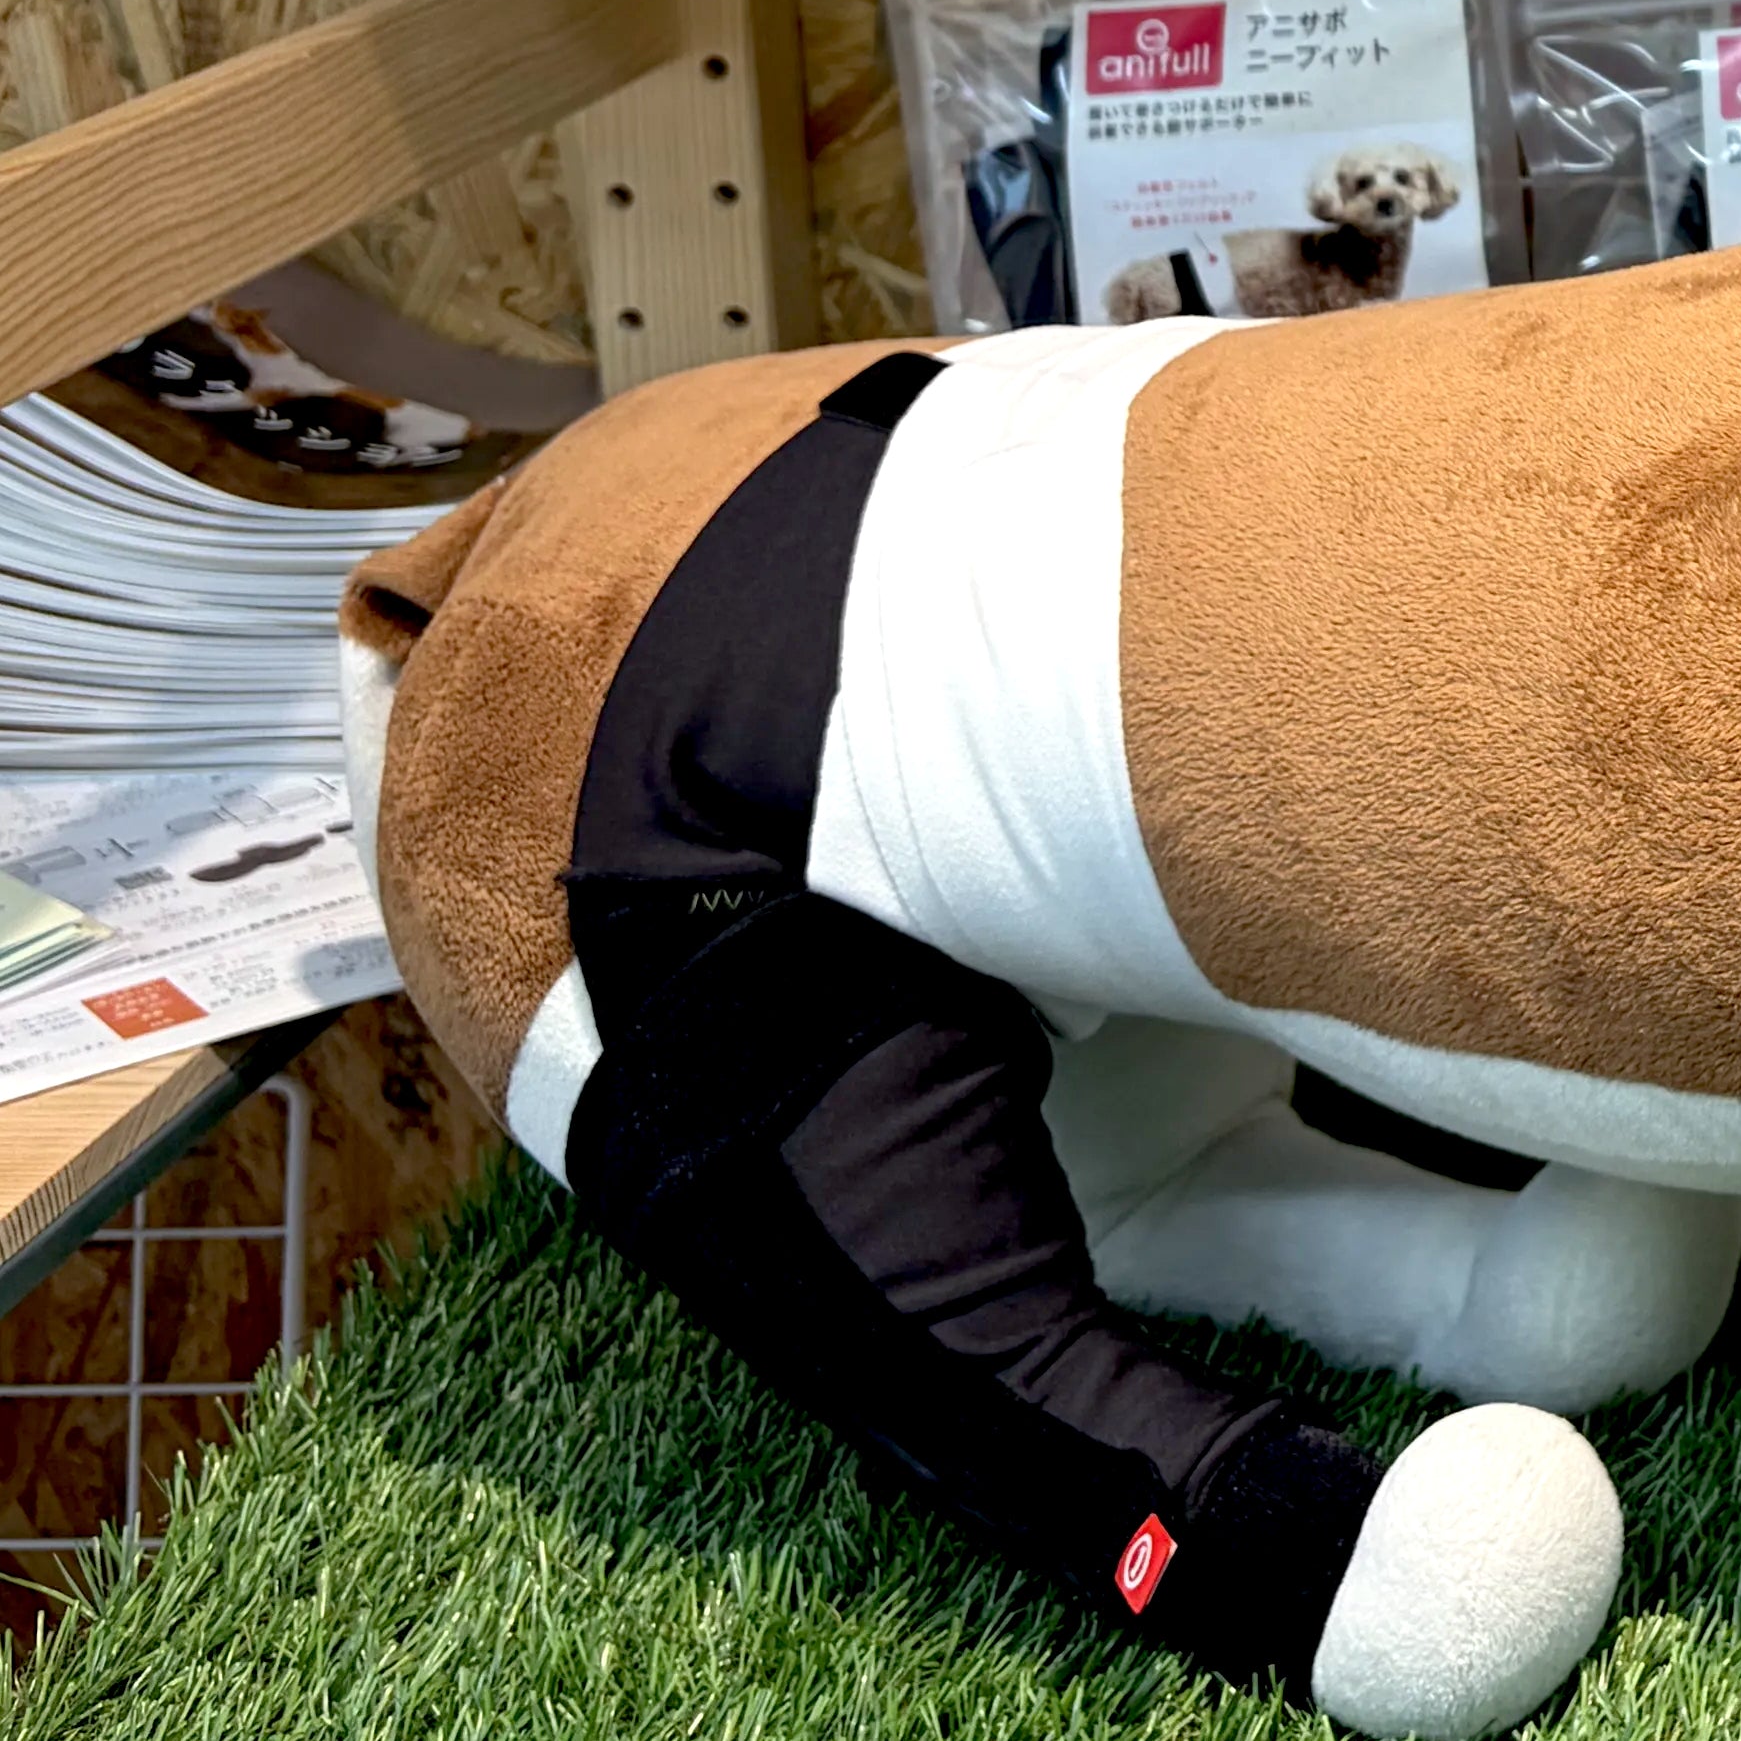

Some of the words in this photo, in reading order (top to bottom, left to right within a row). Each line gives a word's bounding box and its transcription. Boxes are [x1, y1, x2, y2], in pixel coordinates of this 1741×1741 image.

[1246, 6, 1349, 41] アニサポ
[1099, 42, 1211, 82] anifull
